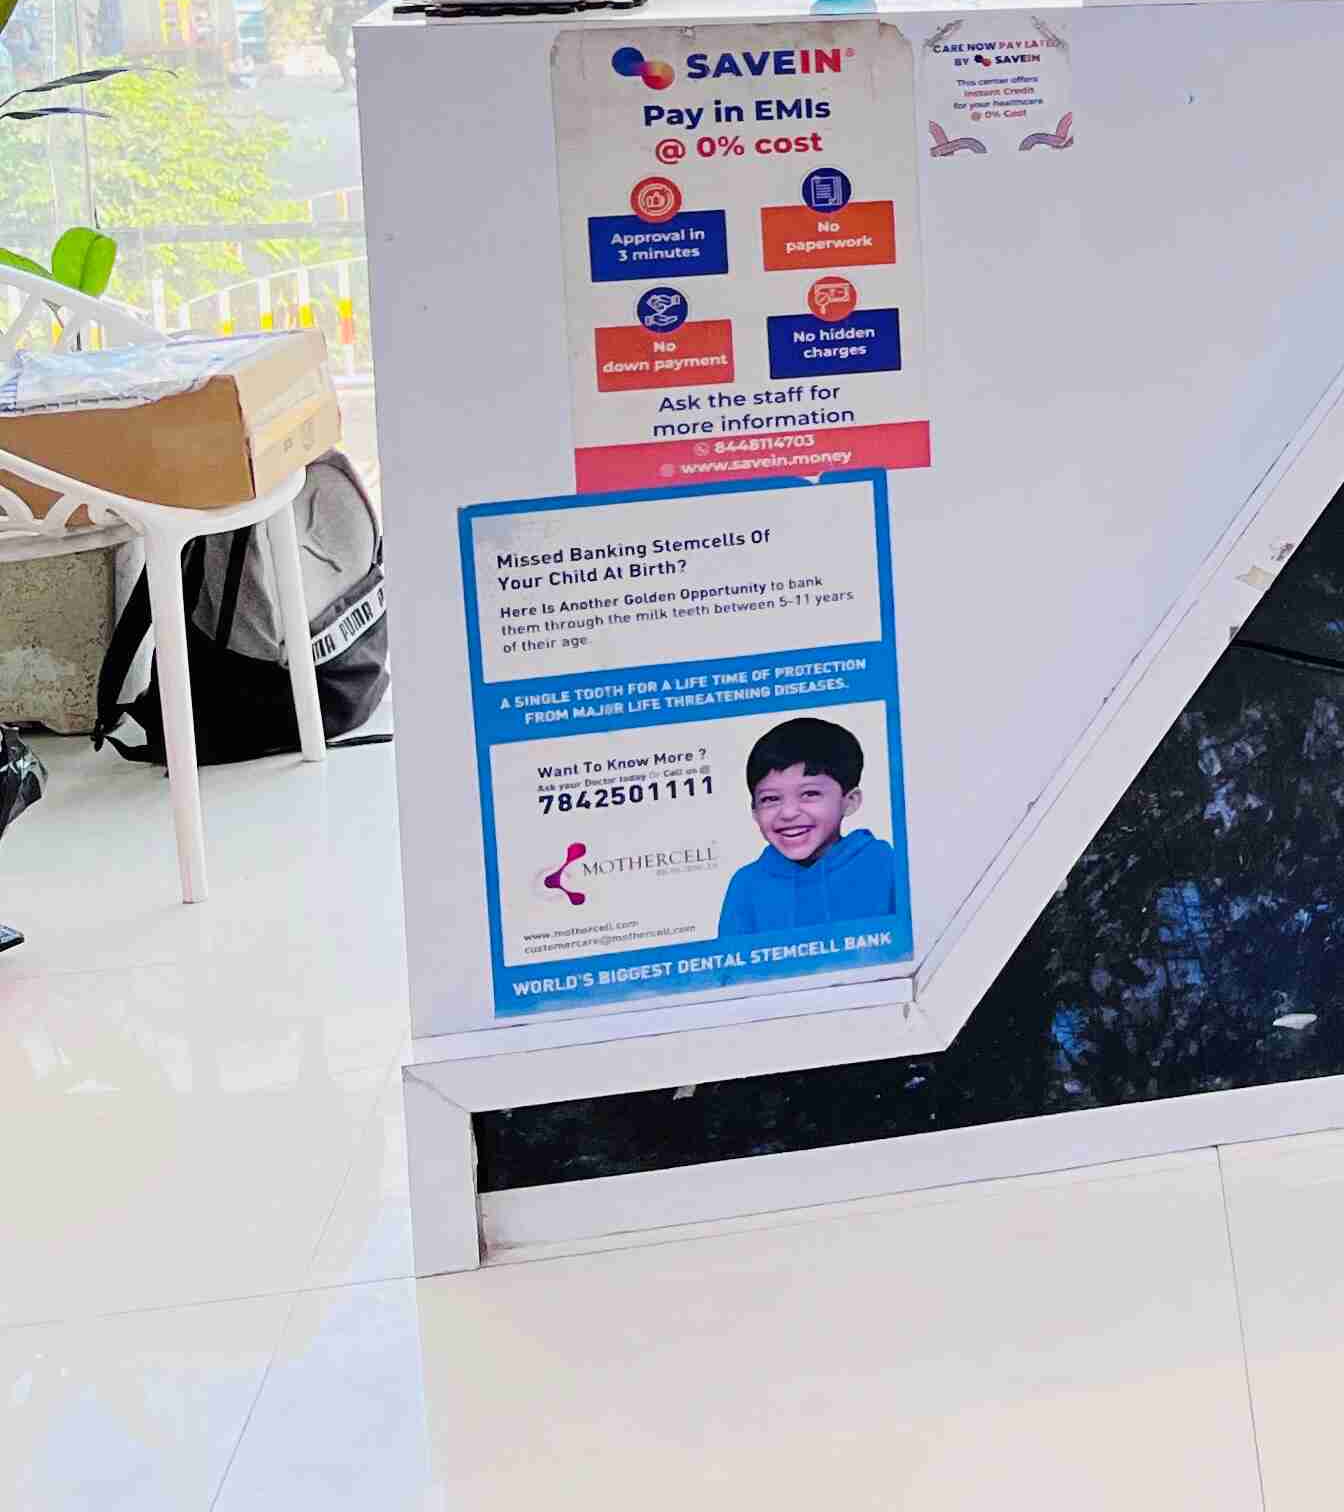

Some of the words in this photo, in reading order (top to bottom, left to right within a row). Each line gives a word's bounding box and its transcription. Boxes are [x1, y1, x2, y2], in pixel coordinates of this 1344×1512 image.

[933, 44, 963, 54] CARE
[967, 41, 996, 51] NOW
[998, 41, 1022, 50] PAY
[954, 57, 969, 66] BY
[995, 54, 1041, 64] SAVEIN
[957, 79, 976, 87] This
[978, 77, 1008, 86] center
[1010, 76, 1038, 84] offers
[964, 89, 1000, 97] Instant
[1004, 87, 1034, 96] Credit
[643, 103, 703, 129] Pay
[714, 100, 744, 122] in
[754, 96, 831, 121] EMIs
[953, 100, 967, 109] for
[969, 101, 990, 111] your
[993, 98, 1043, 107] healthcare
[984, 110, 1001, 118] 0%
[1004, 108, 1026, 117] Cost
[655, 137, 686, 165] @
[696, 136, 745, 158] 0%
[755, 132, 823, 155] cost
[610, 229, 685, 246] Approval
[688, 228, 705, 242] in
[817, 221, 840, 234] No
[618, 249, 628, 263] 3
[632, 245, 700, 260] minutes
[785, 235, 872, 256] paperwork
[793, 328, 816, 343] No
[819, 326, 875, 340] hidden
[653, 340, 676, 354] No
[803, 343, 867, 361] charges
[602, 358, 650, 373] down
[653, 354, 728, 372] payment
[659, 394, 701, 413] Ask
[708, 391, 746, 409] the
[751, 386, 804, 405] staff
[809, 384, 840, 402] for
[652, 417, 714, 438] more
[721, 406, 855, 432] information
[714, 434, 815, 454] 8448114703
[497, 549, 564, 570] Missed
[570, 541, 647, 564] Banking
[652, 531, 746, 554] Stemcells
[750, 528, 770, 545] Of
[498, 573, 544, 592] Your
[548, 567, 599, 586] Child
[603, 564, 625, 581] At
[629, 558, 687, 577] Birth?
[500, 604, 537, 620] Here
[541, 601, 555, 615] Is
[559, 595, 619, 613] Another
[623, 590, 677, 606] Golden
[680, 581, 767, 603] Opportunity
[770, 580, 785, 592] to
[788, 574, 823, 590] bank
[339, 601, 373, 642] PUMA
[501, 619, 540, 637] them
[544, 614, 604, 636] through
[608, 610, 632, 625] the
[636, 607, 667, 623] milk
[672, 602, 710, 619] teeth
[714, 596, 775, 615] between
[779, 594, 811, 608] 5-11
[814, 590, 854, 606] years
[503, 640, 519, 654] of
[522, 636, 557, 652] their
[499, 695, 512, 710] A
[515, 689, 571, 709] SINGLE
[574, 683, 624, 702] TOOTH
[628, 678, 659, 695] FOR
[661, 679, 672, 692] A
[675, 674, 709, 690] LIFE
[713, 670, 749, 688] TIME
[752, 667, 772, 682] OF
[775, 657, 867, 680] PROTECTION
[525, 708, 569, 725] FROM
[573, 702, 625, 721] MAJOR
[628, 696, 662, 713] LIFE
[666, 683, 771, 710] THREATENING
[538, 763, 580, 779] Want
[583, 759, 603, 773] To
[607, 755, 651, 770] Know
[654, 750, 694, 766] More
[699, 748, 706, 761] ?
[538, 774, 714, 815] 7842501111
[583, 847, 715, 877] MOTHERCELL
[513, 971, 594, 997] WORLD'S
[598, 961, 672, 986] BIGGEST
[678, 951, 745, 972] DENTAL
[749, 939, 840, 963] STEMCELL
[844, 930, 891, 952] BANK
